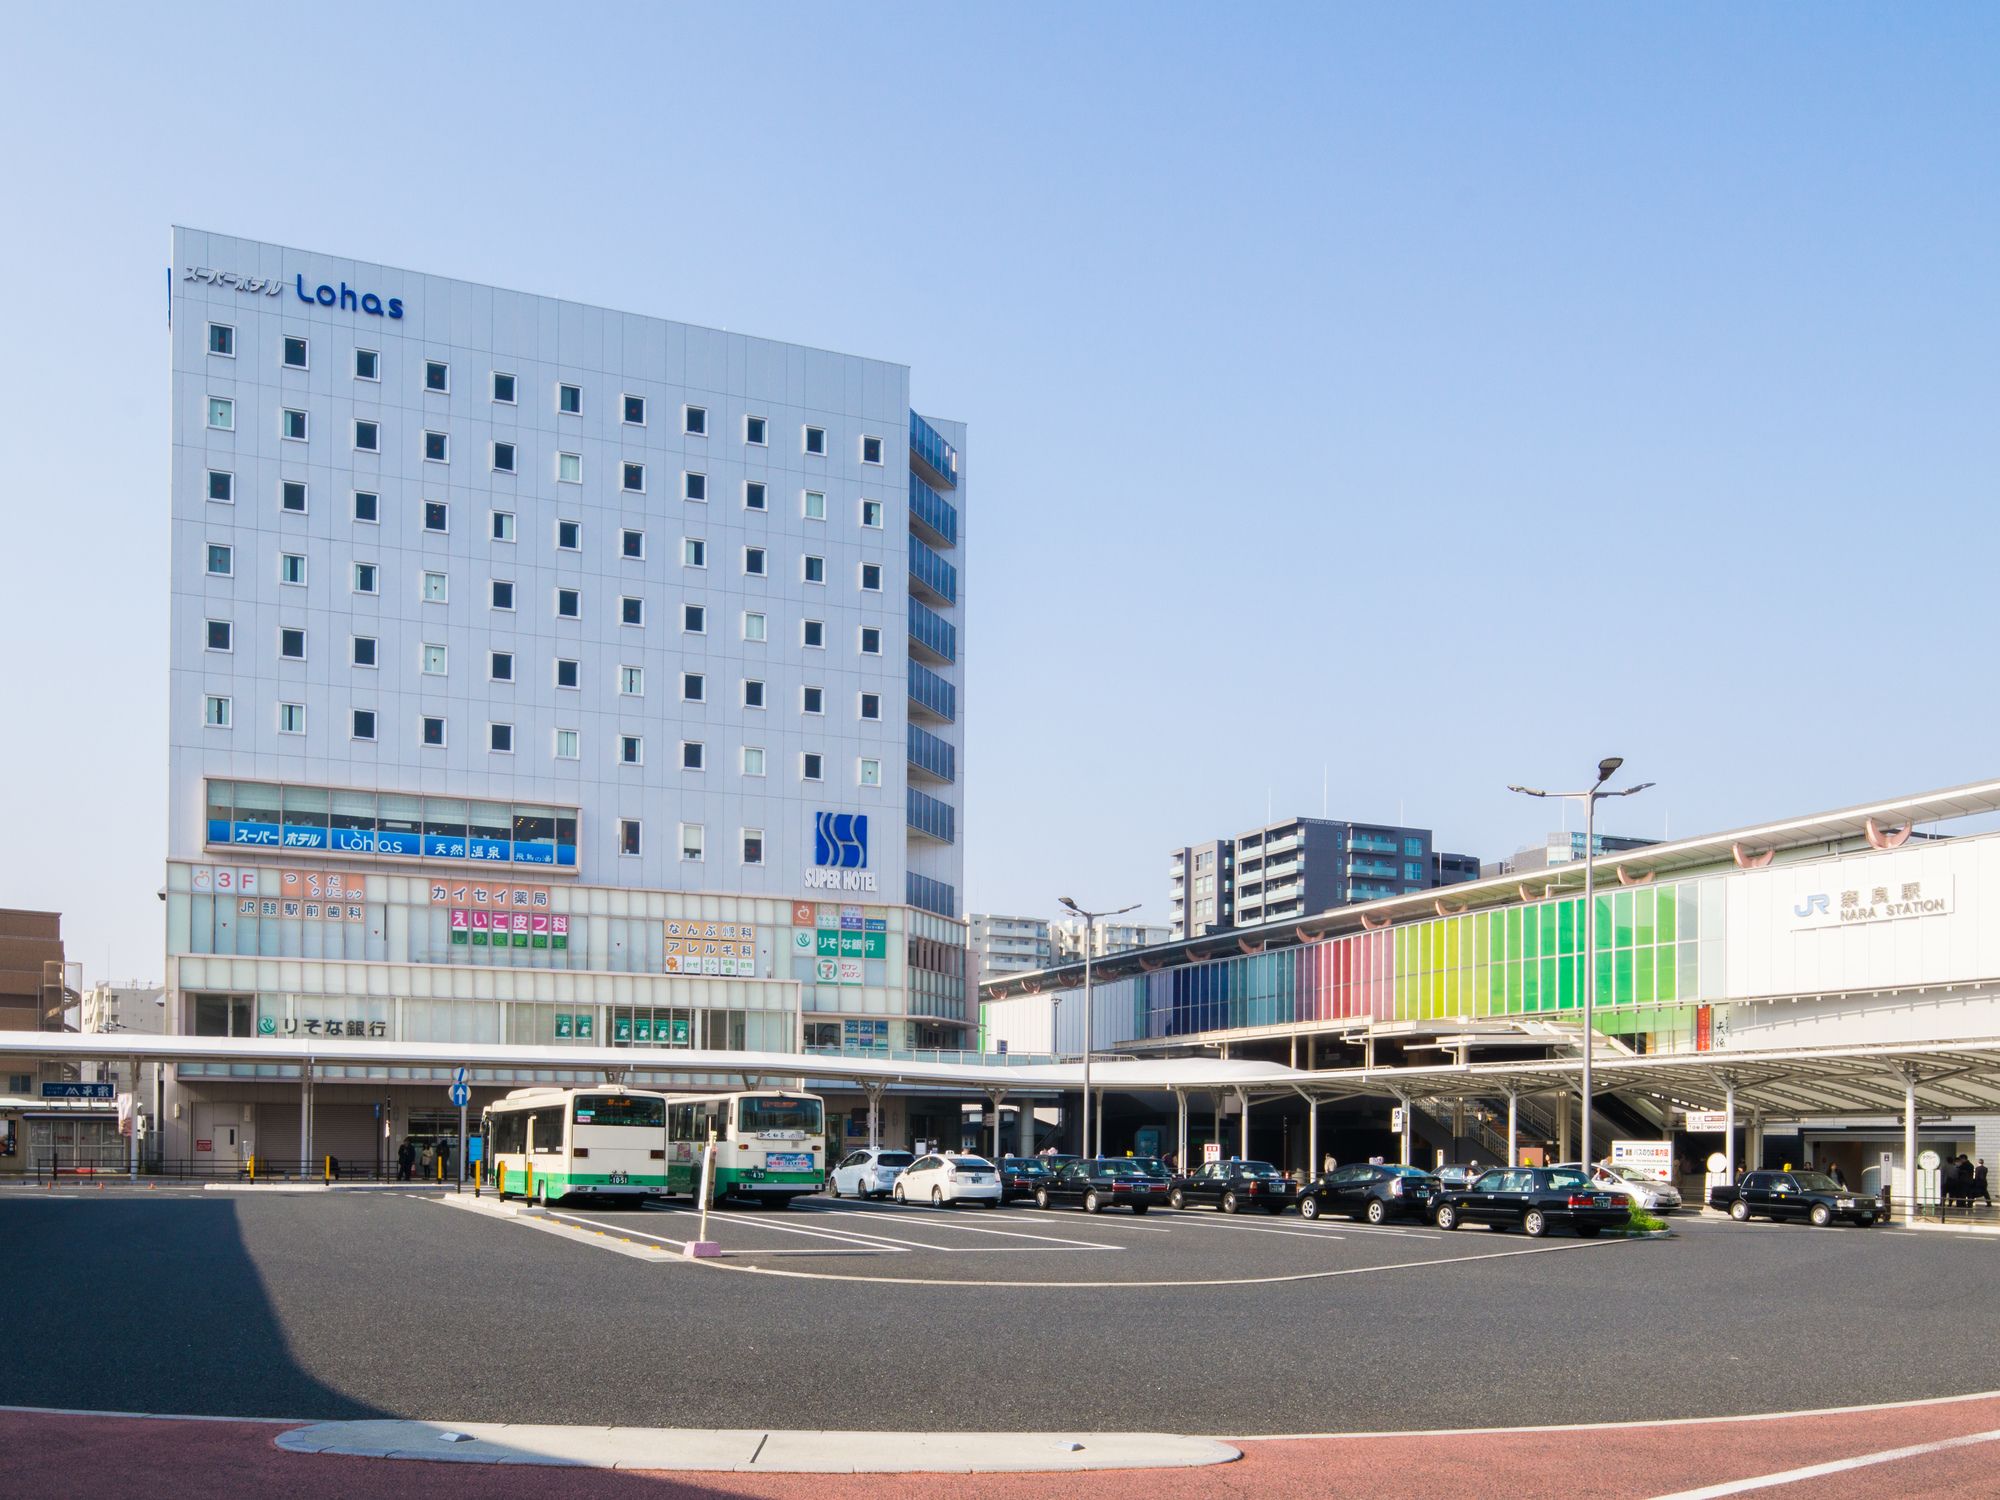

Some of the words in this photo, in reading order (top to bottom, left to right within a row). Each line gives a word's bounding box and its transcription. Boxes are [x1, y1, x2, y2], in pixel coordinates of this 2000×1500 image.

[184, 266, 283, 296] スーパーホテル
[296, 273, 404, 319] Lohas
[236, 829, 321, 848] スーパーホテル
[435, 843, 501, 860] 天然温泉
[218, 872, 254, 889] 3F
[285, 874, 339, 886] つくだ
[804, 867, 841, 890] SUPER
[843, 870, 878, 891] HOTEL
[312, 886, 362, 899] クリニック
[432, 886, 548, 906] カイセイ薬局
[1794, 893, 1830, 918] JR
[1840, 881, 1921, 909] 奈良駅
[240, 901, 362, 919] JR奈良駅前歯科
[1840, 908, 1877, 922] NARA
[1886, 898, 1945, 917] STATION
[453, 911, 568, 932] えいご皮フ科
[668, 923, 752, 939] なんぶ小児科
[668, 941, 752, 957] アレルギー科
[818, 937, 875, 951] りそな銀行
[284, 1018, 386, 1037] りそな銀行
